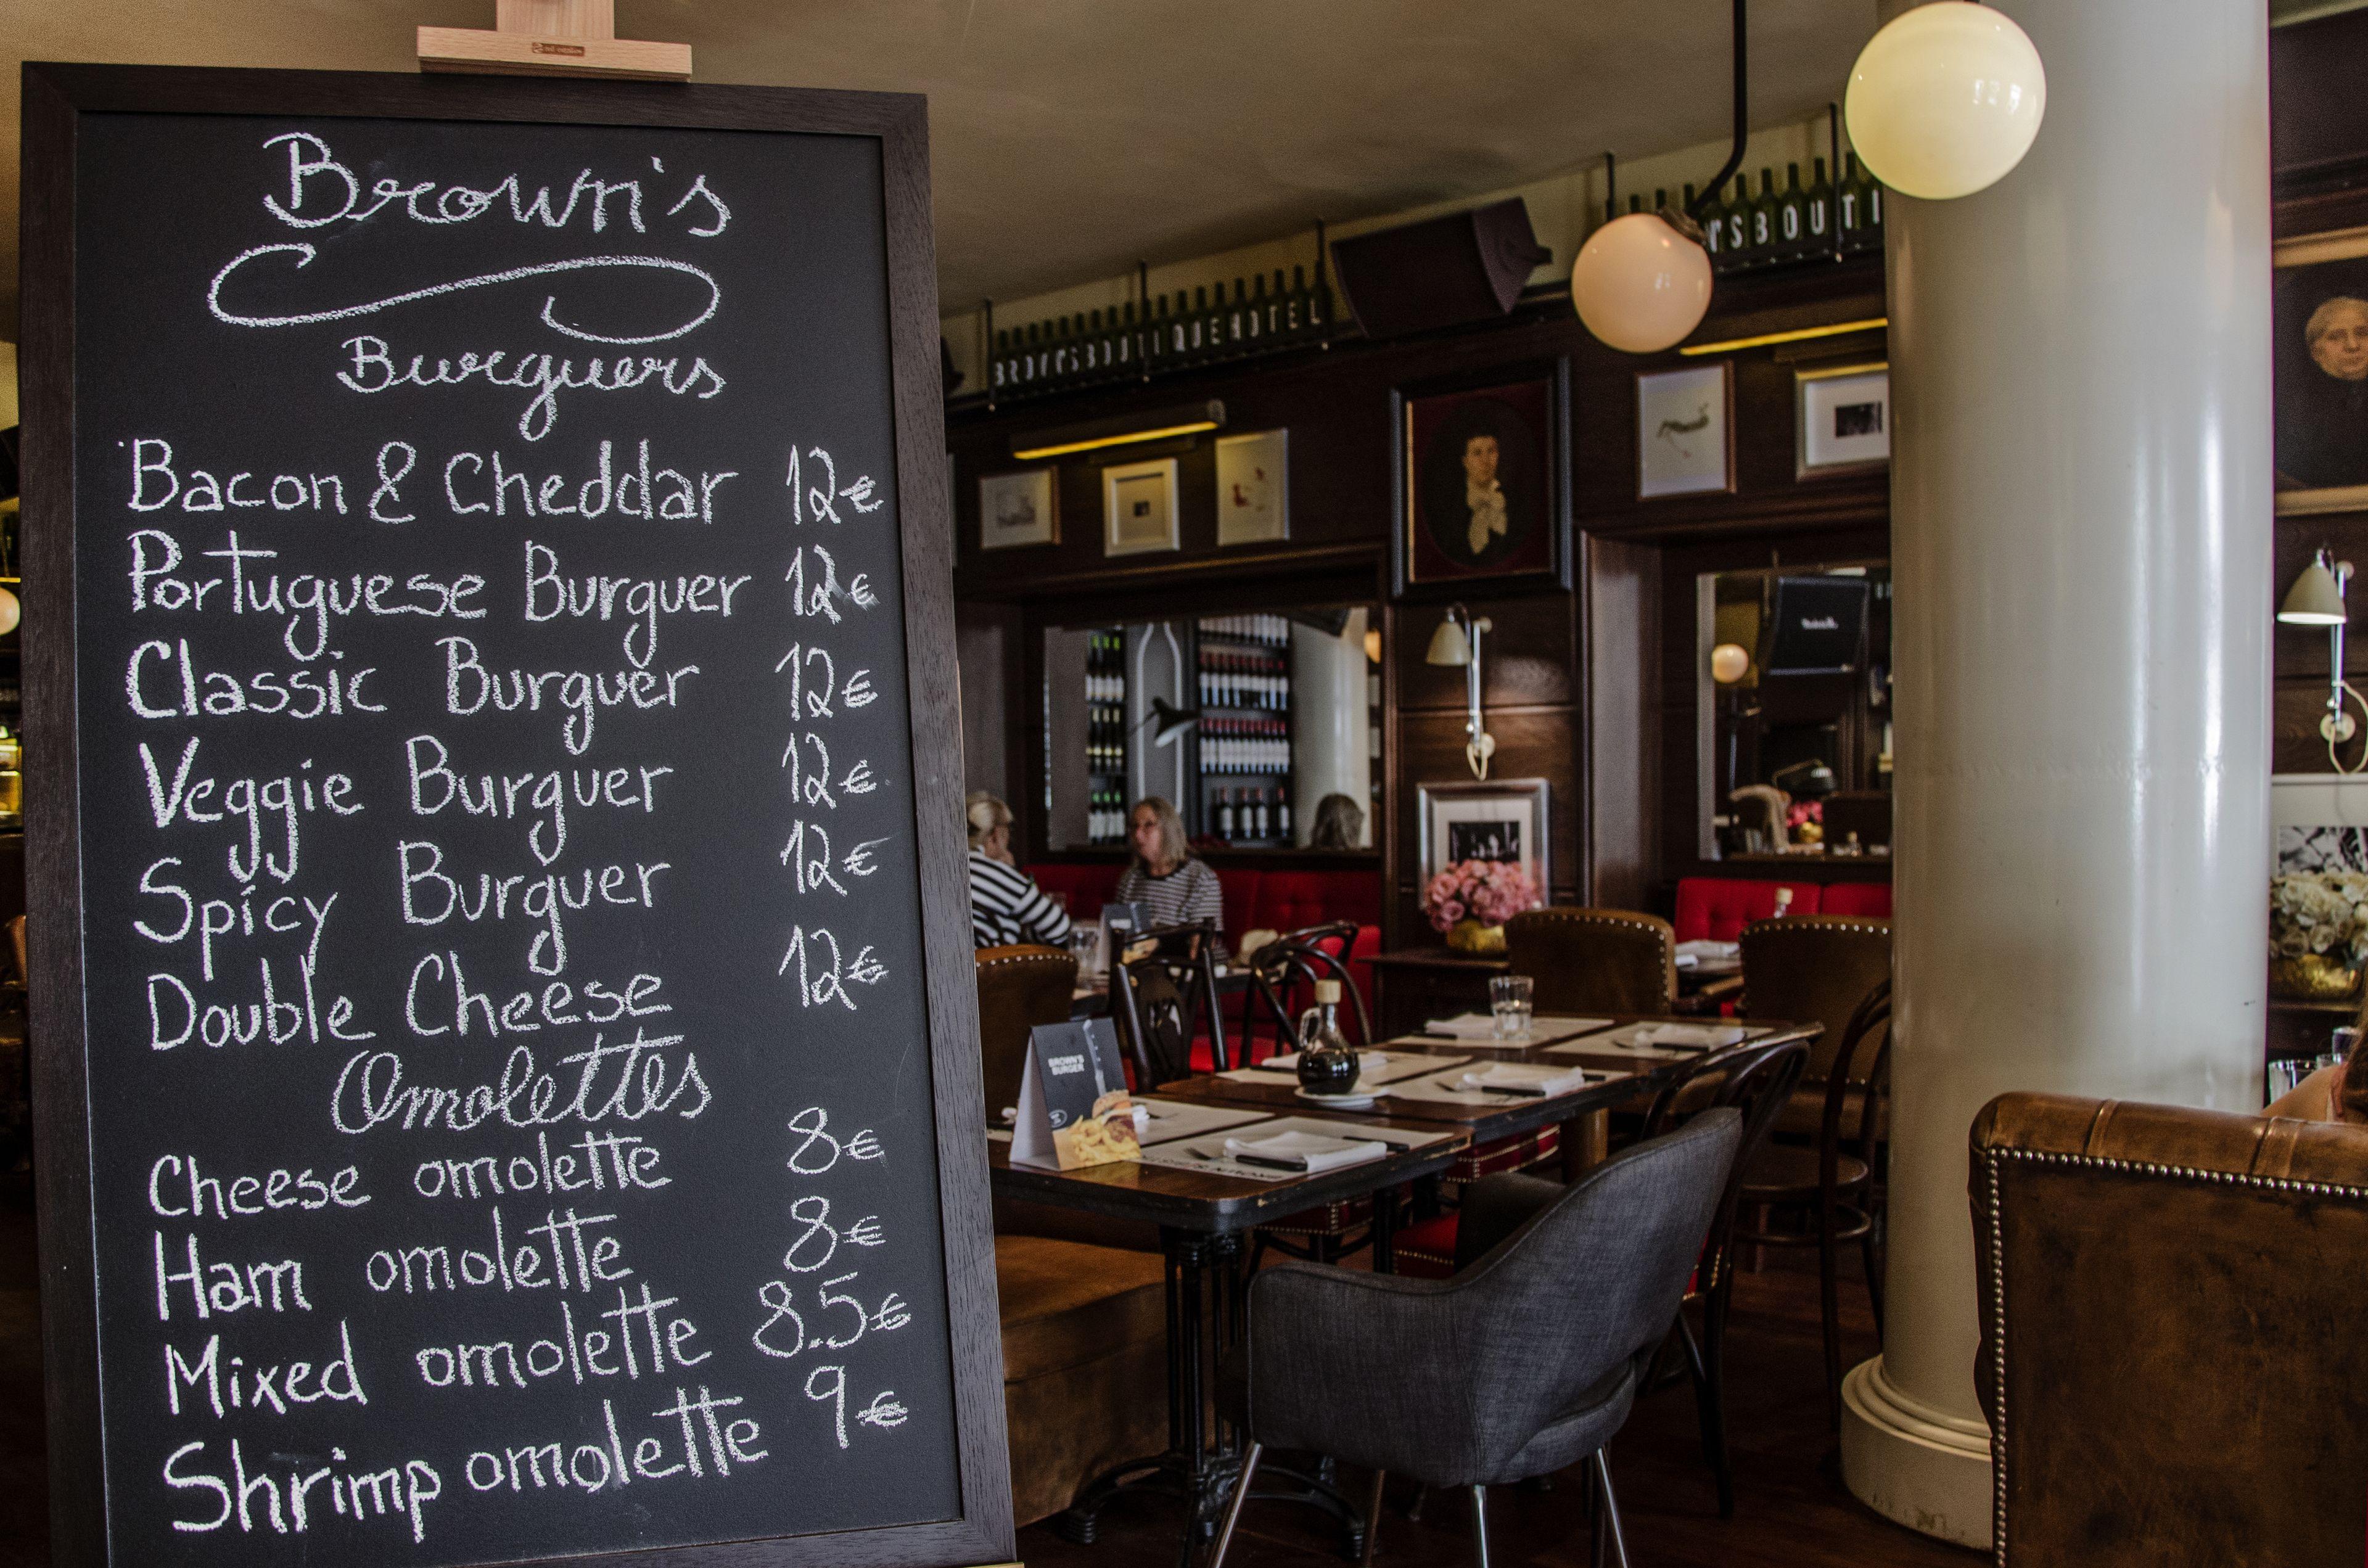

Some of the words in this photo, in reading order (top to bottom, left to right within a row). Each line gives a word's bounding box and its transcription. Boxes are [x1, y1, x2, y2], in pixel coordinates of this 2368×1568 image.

[263, 133, 731, 236] Brown's
[337, 336, 726, 441] Burguers
[128, 439, 347, 514] Bacon
[369, 441, 416, 523] &
[445, 440, 738, 523] Cheddar
[786, 445, 883, 525] 12€
[128, 530, 487, 662] Portuguese
[525, 540, 751, 668] Burguer
[785, 544, 876, 624] 12€
[126, 639, 387, 719] Classic
[435, 638, 699, 755] Burguer
[775, 642, 878, 721] 12€
[139, 737, 364, 882] Veggie
[406, 735, 673, 866] Burguer
[782, 733, 877, 809] 12€
[134, 858, 337, 981] Spicy
[397, 840, 670, 975] Burguer
[780, 819, 888, 896] 12€
[148, 958, 376, 1050] Double
[406, 951, 672, 1036] Cheese
[779, 925, 889, 1011] 12€
[332, 1027, 712, 1134] Omolettes
[149, 1155, 371, 1219] Cheese
[414, 1131, 672, 1198] omolette
[787, 1107, 884, 1175] 8€
[155, 1231, 311, 1320] Ham
[367, 1207, 633, 1293] omolette
[783, 1196, 886, 1272] 8€
[165, 1321, 368, 1418] Mixed
[416, 1284, 712, 1387] omolette
[752, 1271, 911, 1358] 8.5€
[164, 1439, 441, 1543] Shrimp
[466, 1386, 768, 1493] omolette
[804, 1366, 908, 1448] 9€
